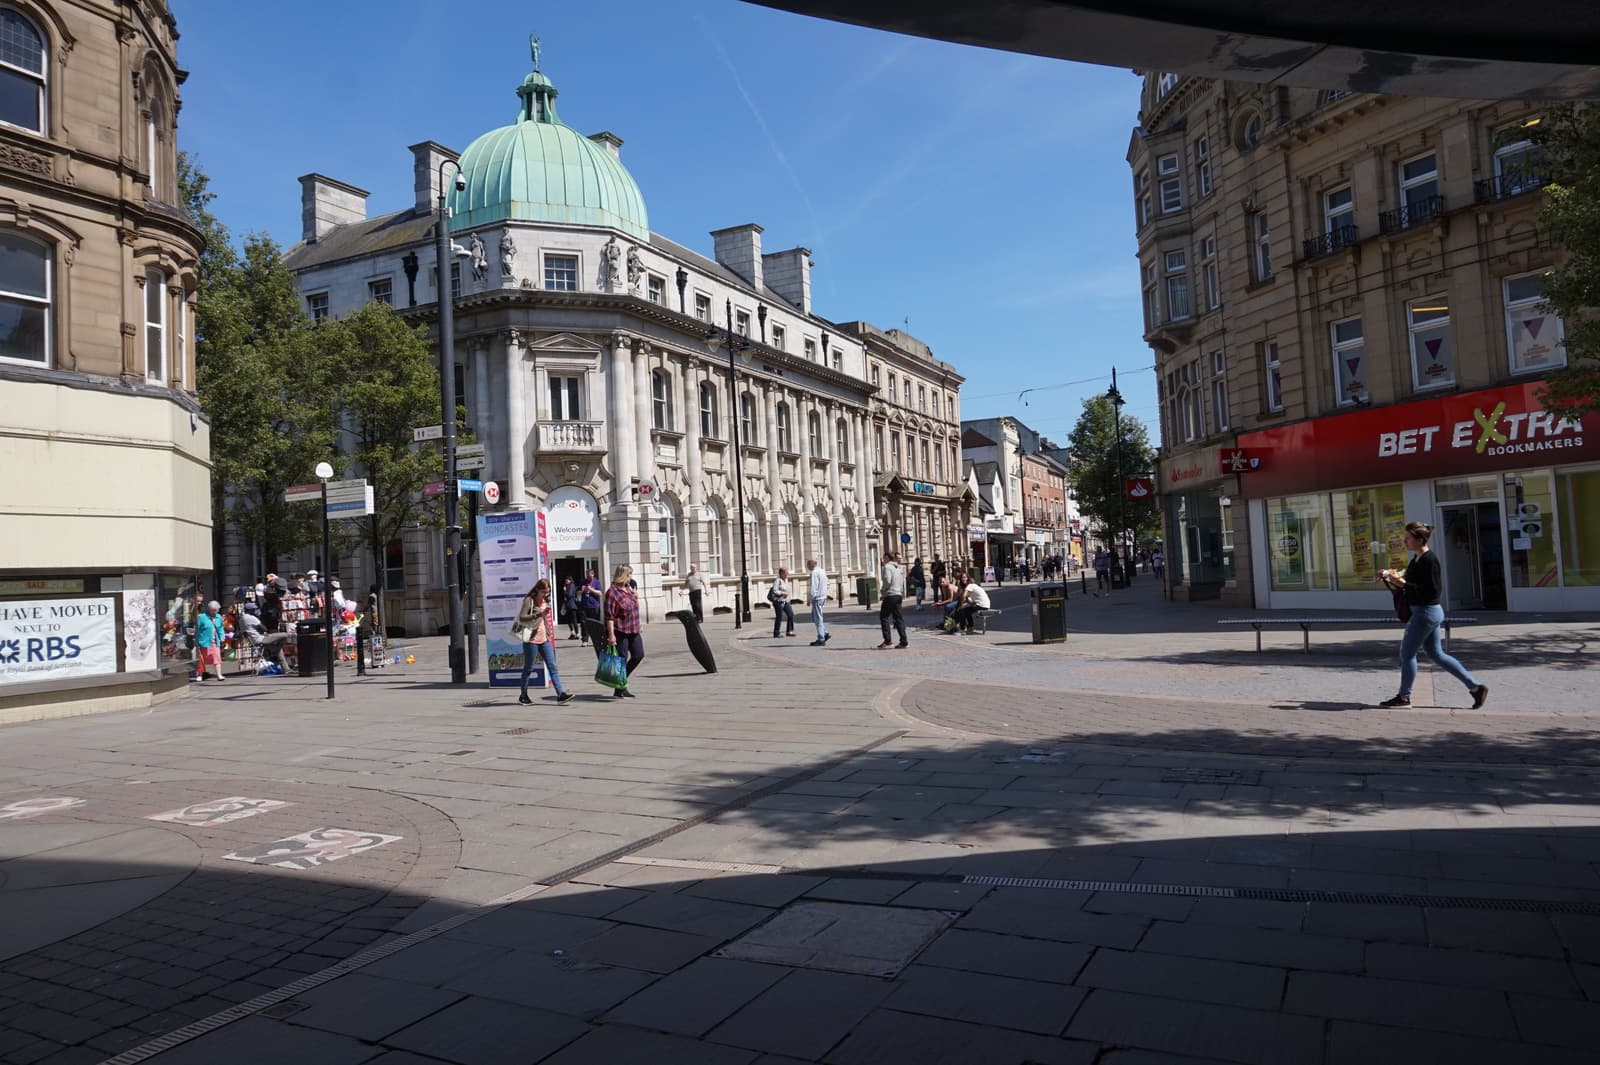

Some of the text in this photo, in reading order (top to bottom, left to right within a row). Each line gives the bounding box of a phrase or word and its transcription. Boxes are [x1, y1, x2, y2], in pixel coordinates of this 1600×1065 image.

[1378, 401, 1583, 457] BET EXTRA
[1488, 436, 1583, 456] BOOKMAKERS
[50, 604, 108, 617] MOVED
[14, 623, 61, 633] NEXT TO
[27, 635, 81, 662] RBS
